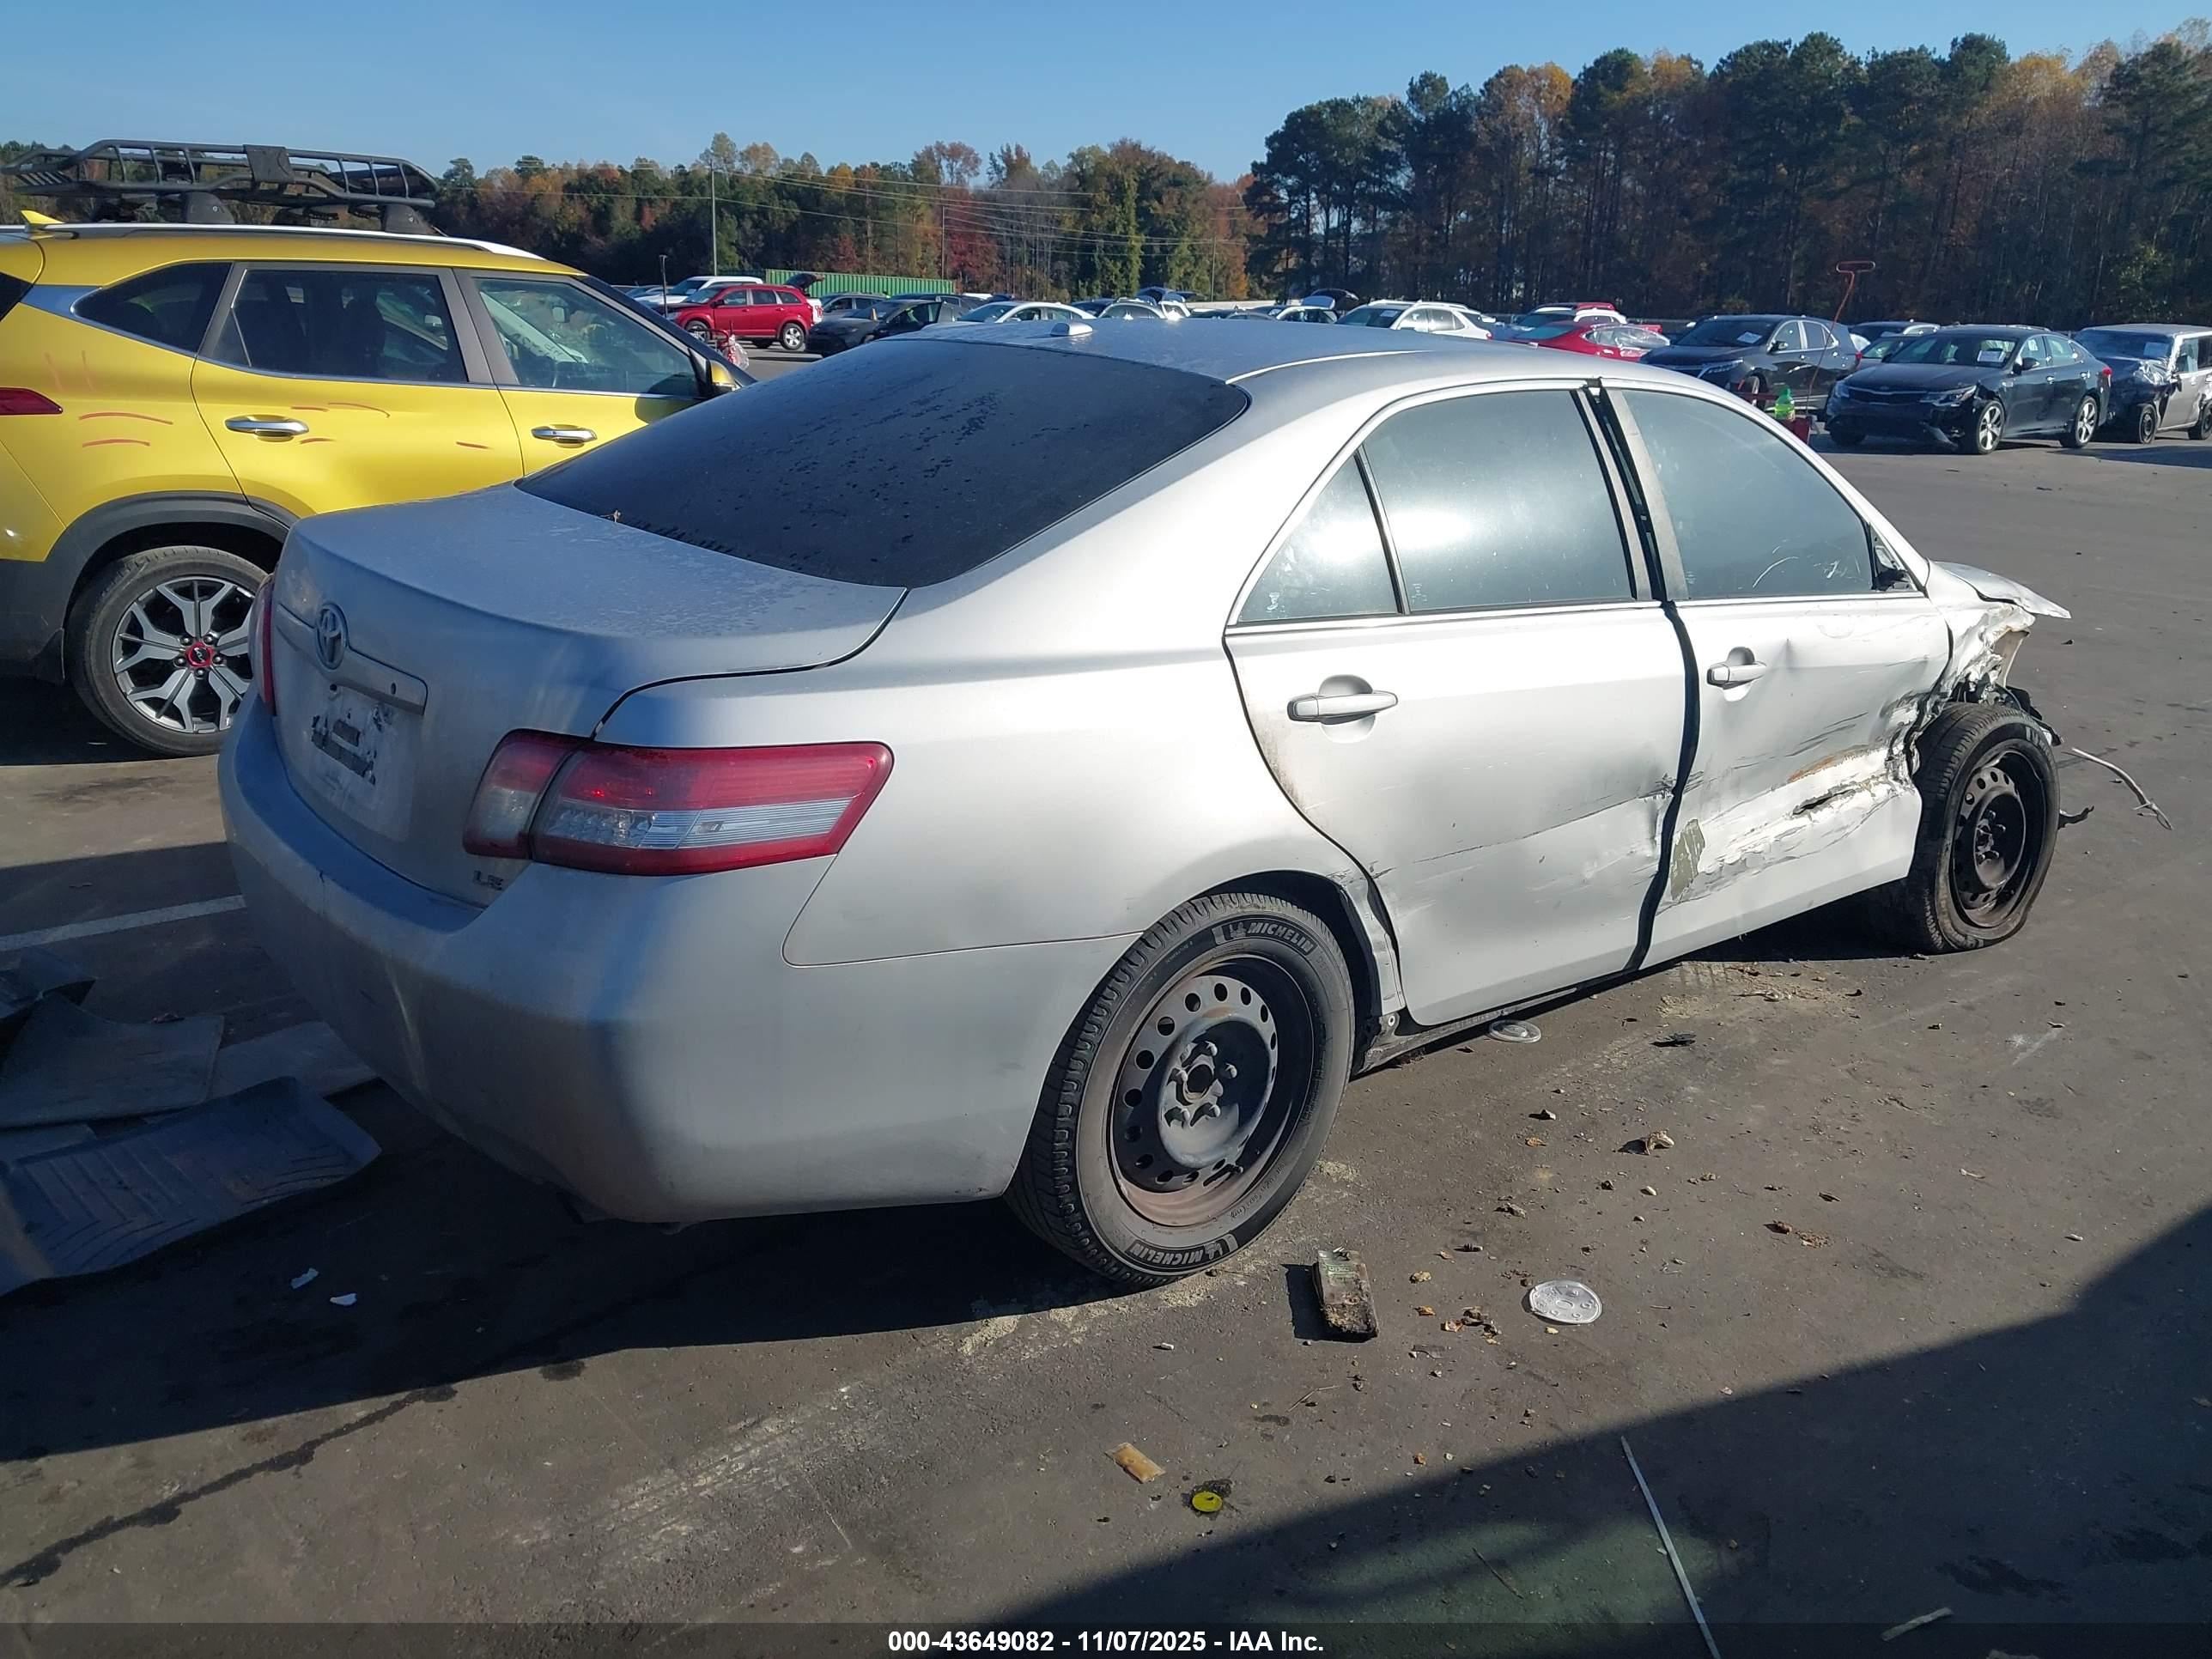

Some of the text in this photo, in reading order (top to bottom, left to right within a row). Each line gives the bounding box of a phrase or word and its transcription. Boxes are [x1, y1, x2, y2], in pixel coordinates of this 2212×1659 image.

[473, 870, 503, 890] LE
[1247, 921, 1315, 952] MICHELIN
[1129, 1243, 1204, 1266] MICHELIN
